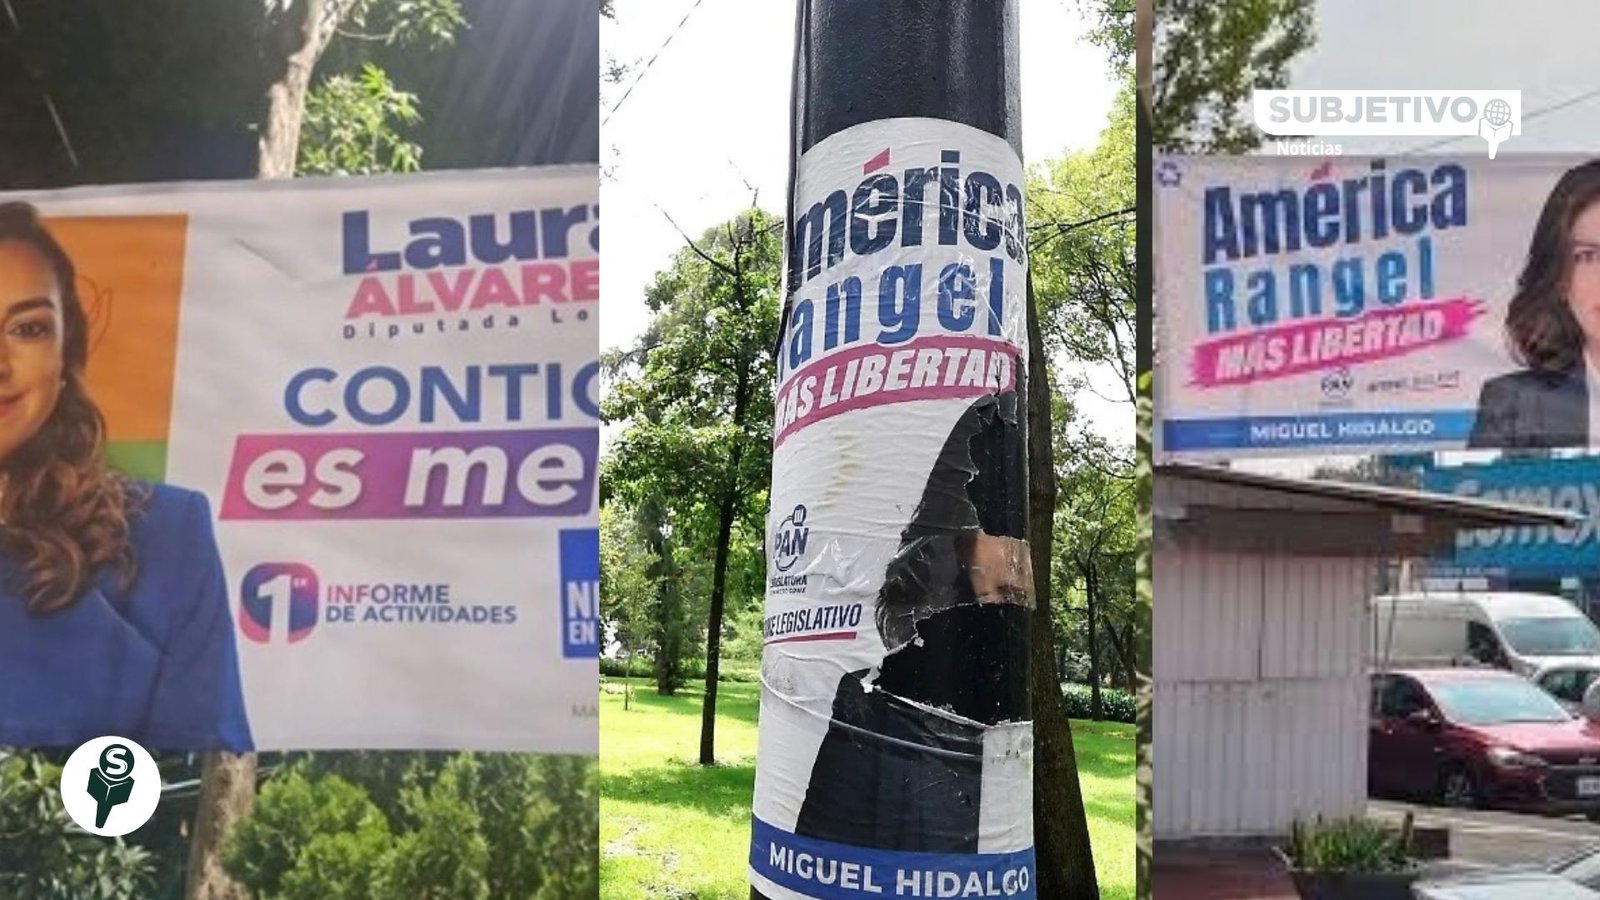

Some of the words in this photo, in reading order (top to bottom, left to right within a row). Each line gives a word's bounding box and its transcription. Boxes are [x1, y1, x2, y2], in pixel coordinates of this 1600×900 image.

[1203, 159, 1468, 265] América
[342, 204, 599, 276] Laur
[1205, 236, 1434, 333] Rangel
[343, 314, 520, 339] Diputada
[551, 309, 589, 324] Lo
[1215, 336, 1285, 379] MÁS
[1291, 309, 1445, 364] LIBERTAD
[819, 347, 1010, 409] LIBERTAD
[1250, 422, 1331, 441] MIGUEL
[1338, 419, 1436, 436] HIDALGO
[242, 448, 366, 510] es
[403, 444, 585, 507] me
[774, 528, 809, 557] PAN
[325, 606, 355, 623] DE
[362, 605, 517, 625] ACTIVIDADES
[326, 584, 450, 605] INFORME
[568, 620, 596, 645] EN
[776, 603, 862, 635] LEGISLATIVO
[769, 842, 882, 893] MIGUEL
[896, 865, 1029, 898] HIDALGO
